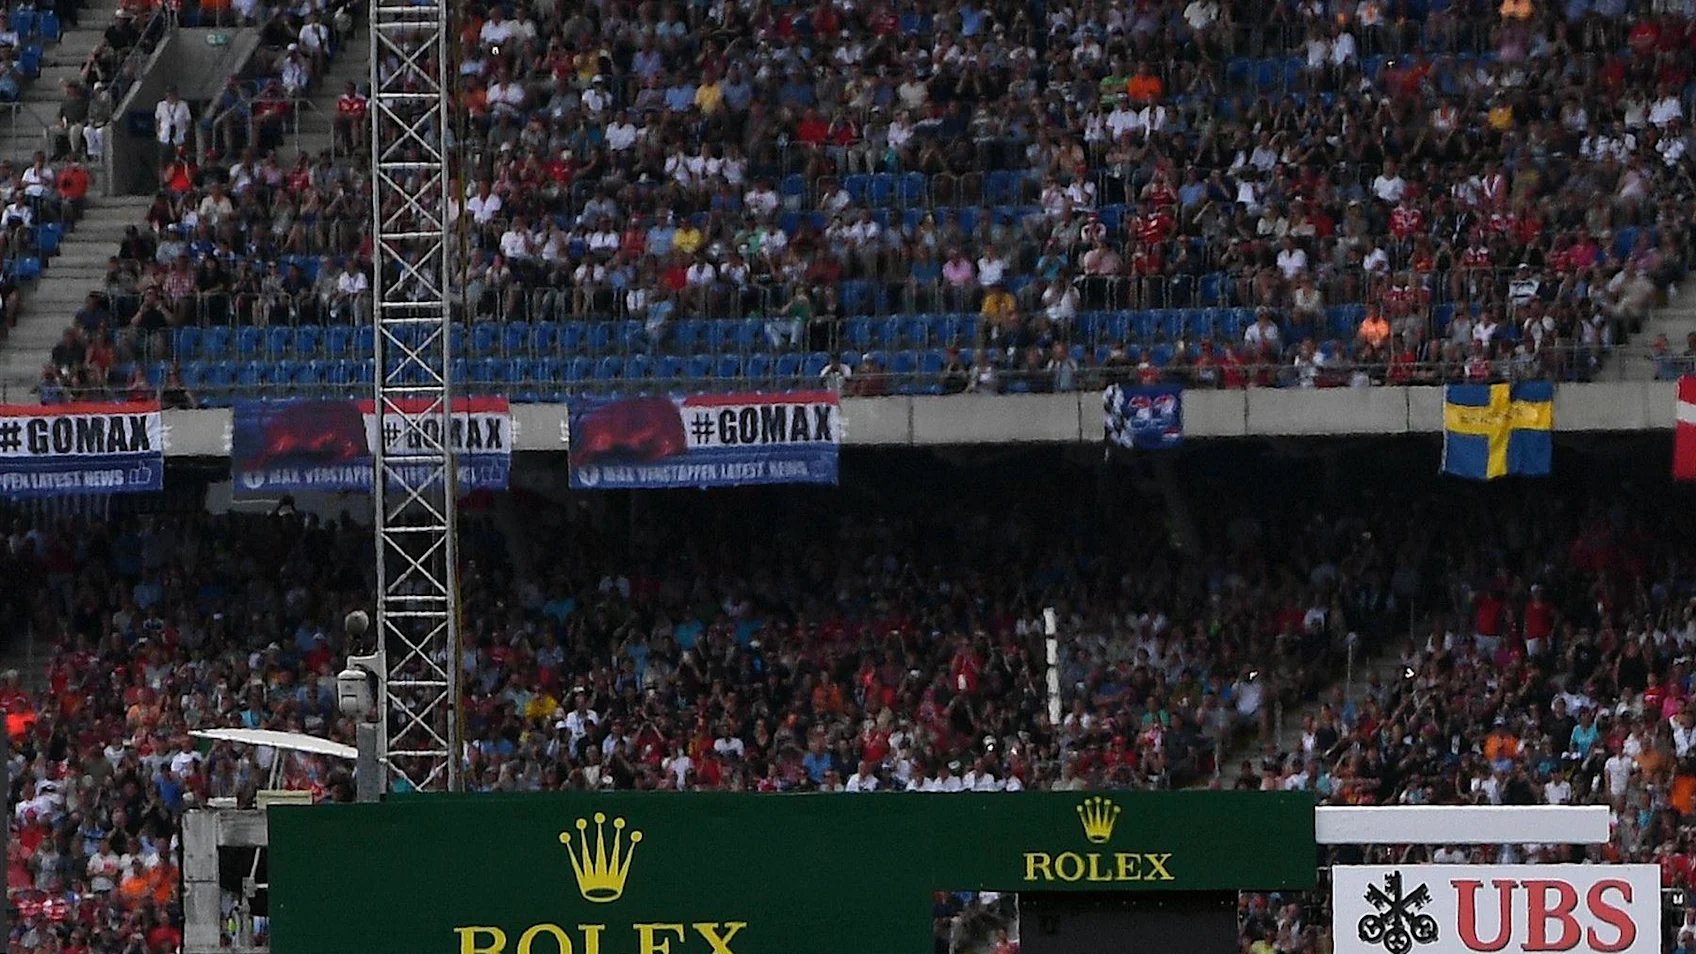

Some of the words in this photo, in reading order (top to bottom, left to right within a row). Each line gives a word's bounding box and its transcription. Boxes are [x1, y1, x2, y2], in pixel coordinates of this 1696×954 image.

[0, 415, 150, 454] #GOMAX
[691, 405, 832, 444] #GOMAX
[84, 469, 124, 487] NEWS
[1023, 851, 1175, 882] ROLEX
[1451, 878, 1638, 953] UBS
